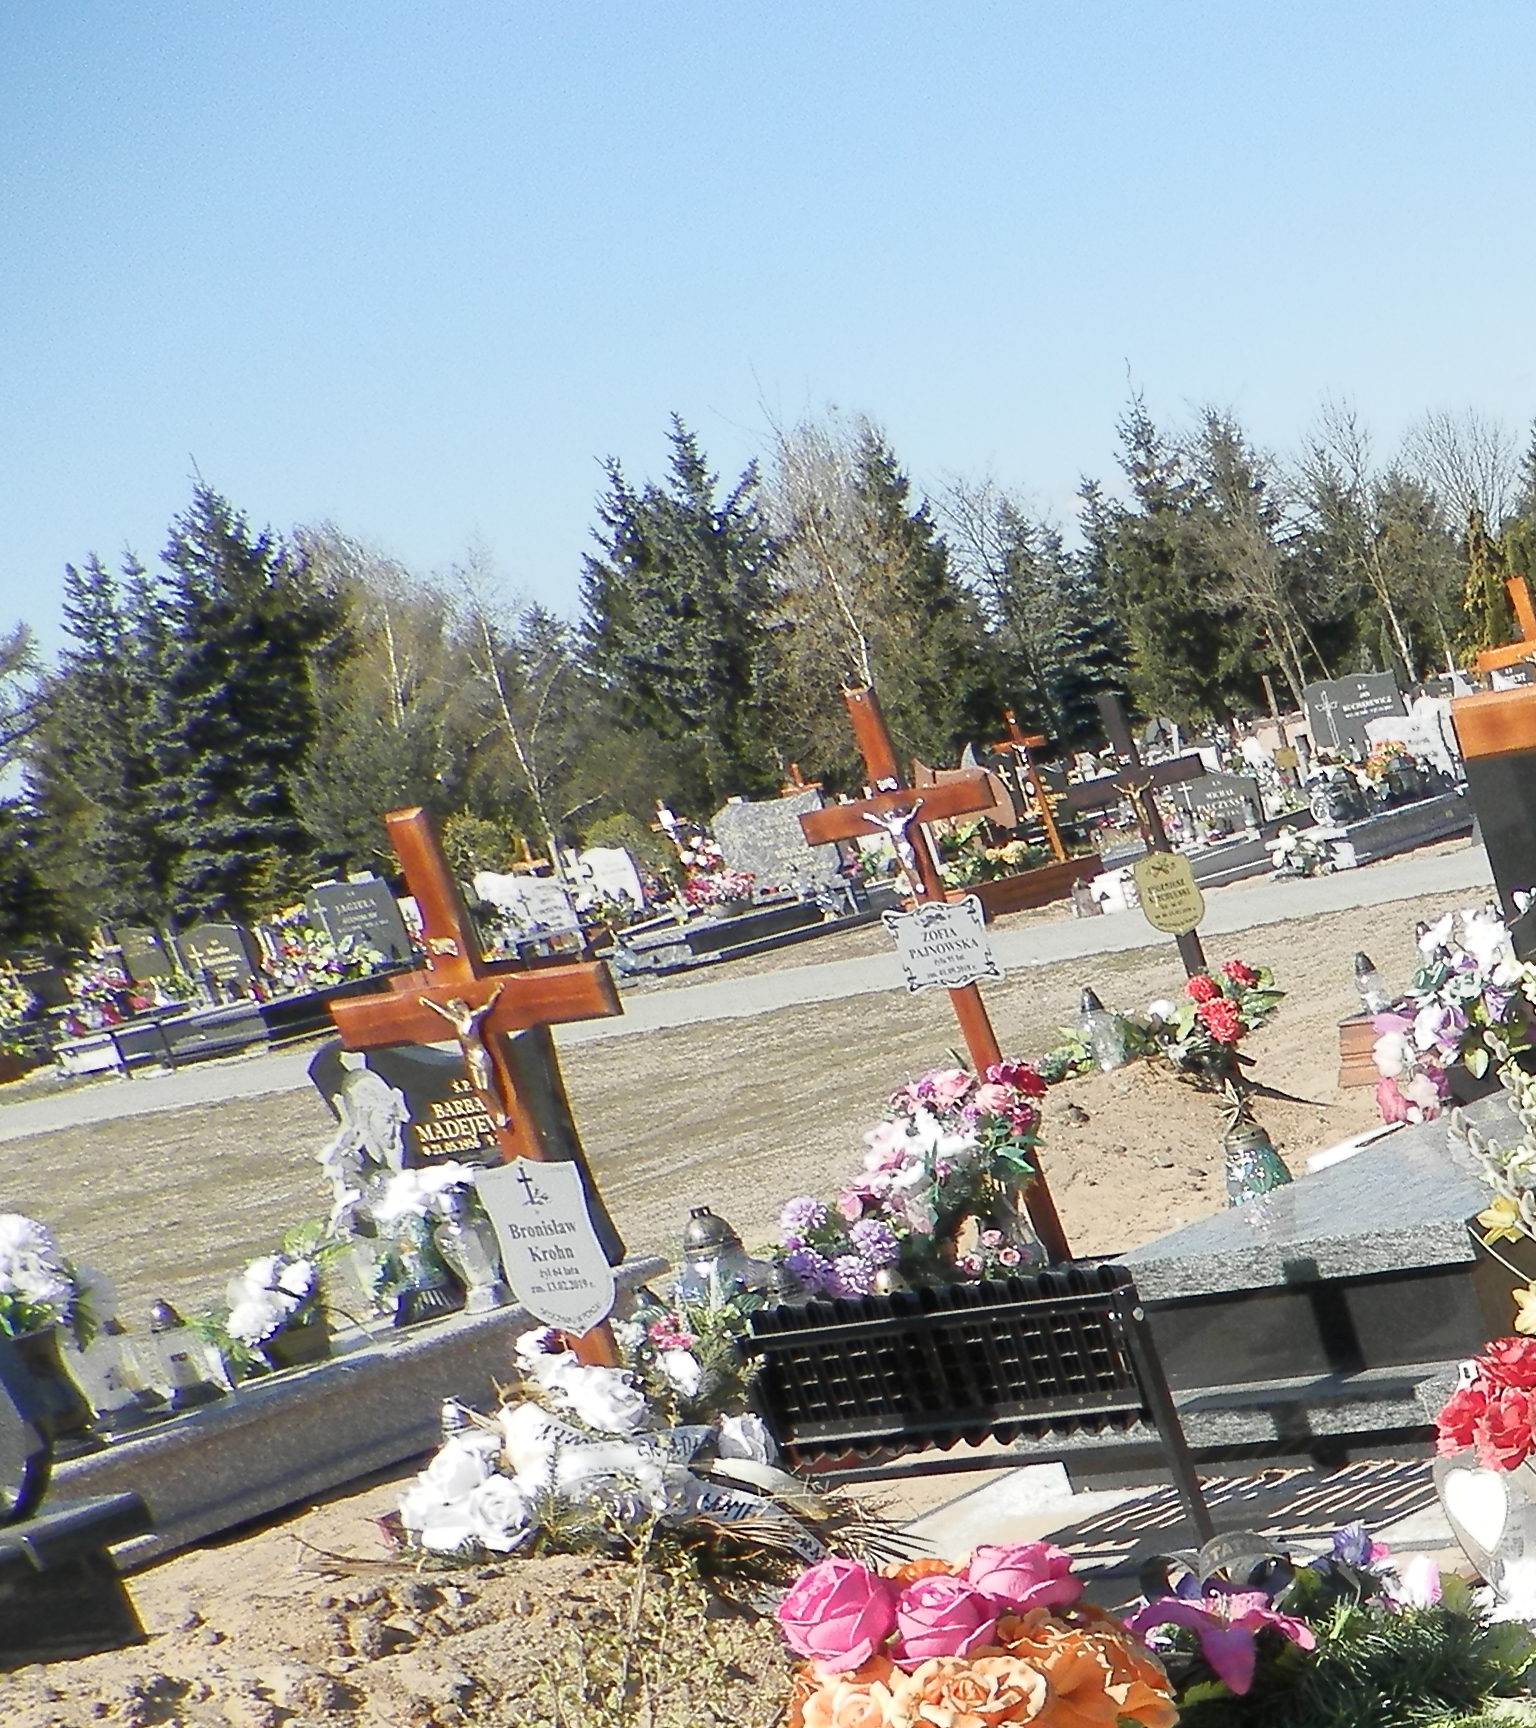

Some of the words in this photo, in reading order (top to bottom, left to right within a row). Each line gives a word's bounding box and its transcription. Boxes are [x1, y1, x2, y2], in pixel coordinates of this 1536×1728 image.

[921, 927, 958, 943] ZOFIA
[908, 938, 979, 960] PAJNOWSKA
[431, 1096, 487, 1119] BARBA
[508, 1218, 577, 1240] Bronisław
[527, 1245, 575, 1263] Krohn
